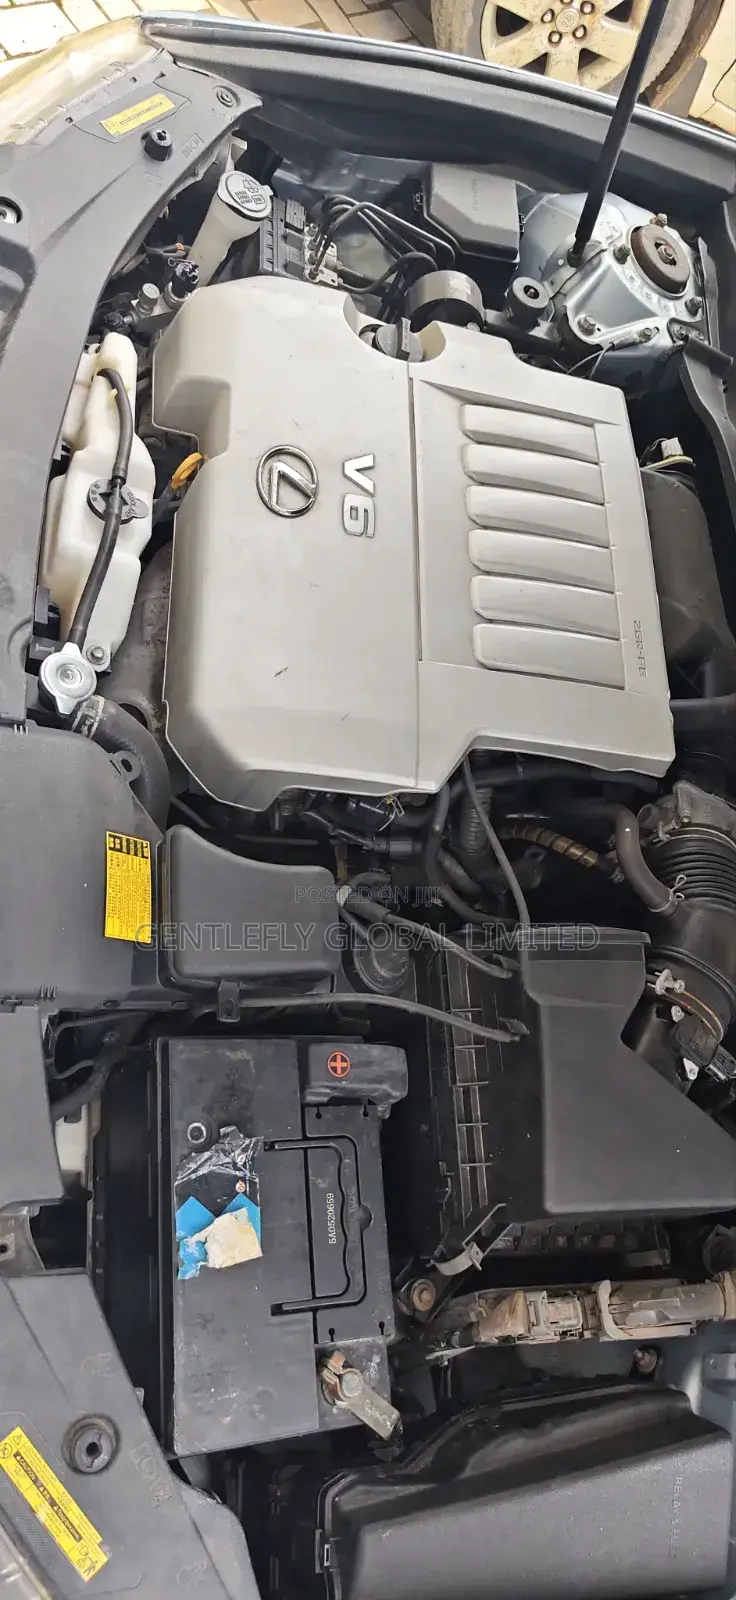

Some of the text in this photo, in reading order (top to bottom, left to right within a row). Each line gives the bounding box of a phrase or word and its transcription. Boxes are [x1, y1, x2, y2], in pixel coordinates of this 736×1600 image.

[342, 453, 376, 538] V6
[633, 620, 647, 677] 2GR-FE
[327, 1192, 336, 1244] 5A0520659
[673, 1477, 682, 1515] RELAY
